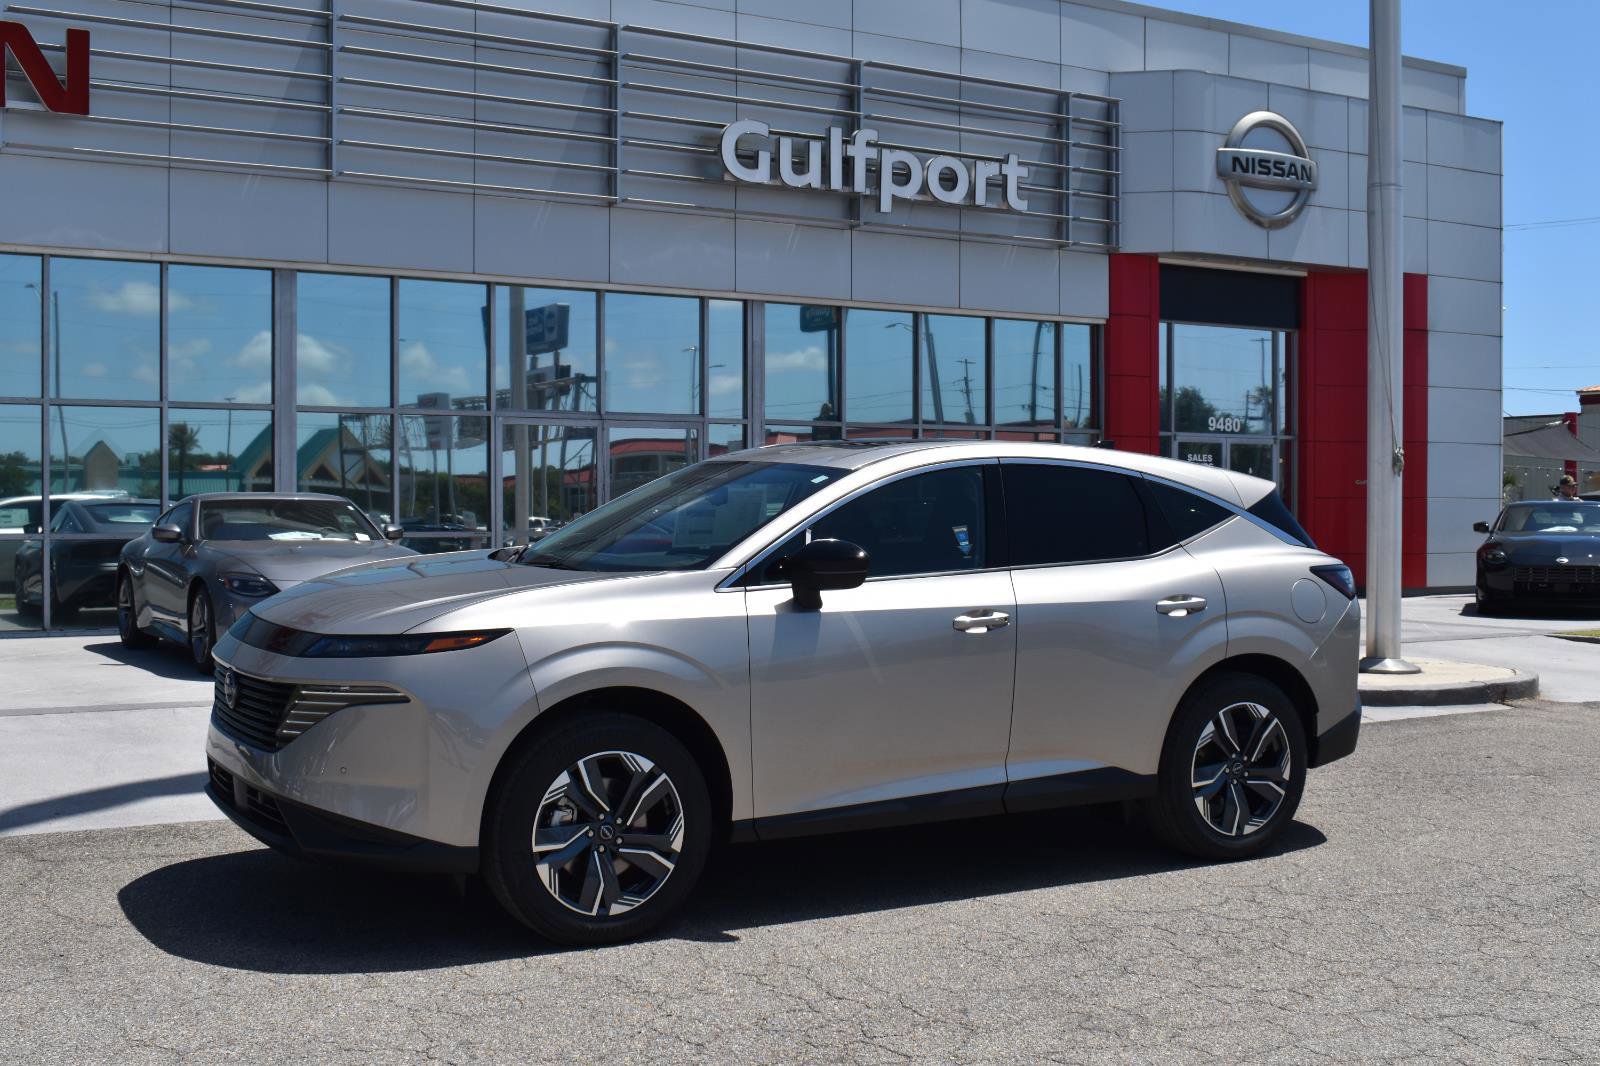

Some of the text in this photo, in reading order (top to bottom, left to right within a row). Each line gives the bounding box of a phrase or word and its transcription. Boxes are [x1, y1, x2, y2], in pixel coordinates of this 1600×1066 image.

[721, 119, 1028, 212] Gulfport
[1232, 156, 1312, 182] NISSAN
[1208, 416, 1241, 432] 9480
[1187, 453, 1213, 462] SALES
